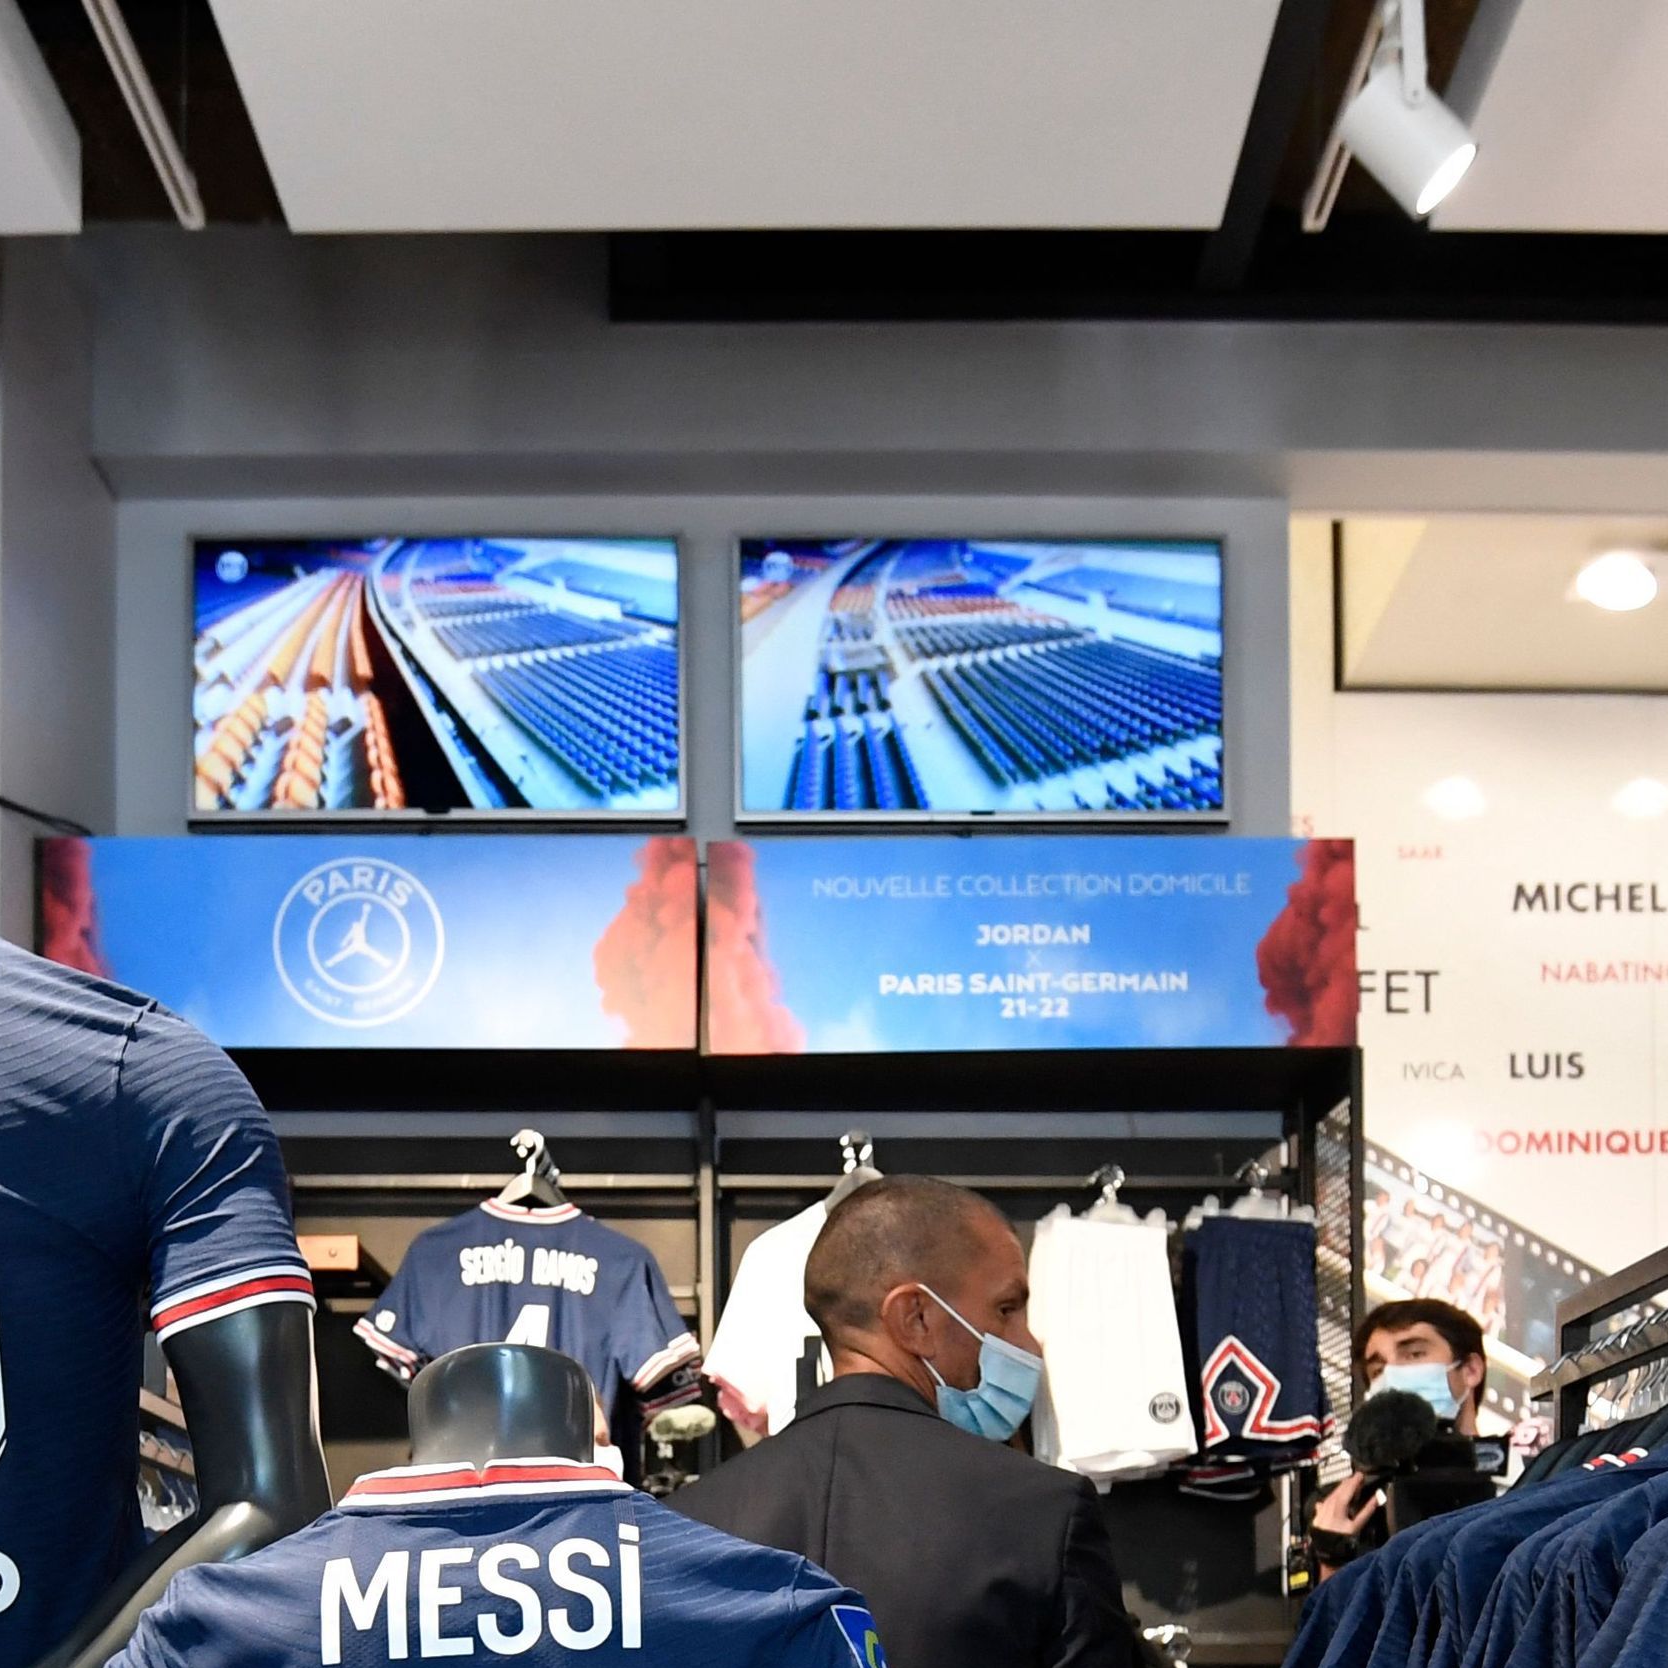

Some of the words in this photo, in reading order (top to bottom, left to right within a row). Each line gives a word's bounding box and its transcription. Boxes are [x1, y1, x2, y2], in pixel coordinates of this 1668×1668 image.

[302, 865, 414, 907] PARIS
[812, 876, 951, 899] NOUVELLE
[958, 873, 1122, 898] COLLECTION
[1128, 872, 1252, 896] DOMICILE
[1512, 882, 1668, 914] MICHEL
[976, 923, 1091, 946] JORDAN
[879, 973, 963, 996] PARIS
[969, 972, 1189, 995] SAINT-GERMAIN
[1001, 997, 1071, 1019] 21-22
[1402, 1063, 1465, 1081] IVICA
[1509, 1052, 1585, 1080] LUIS
[532, 1247, 598, 1295] RAMOS
